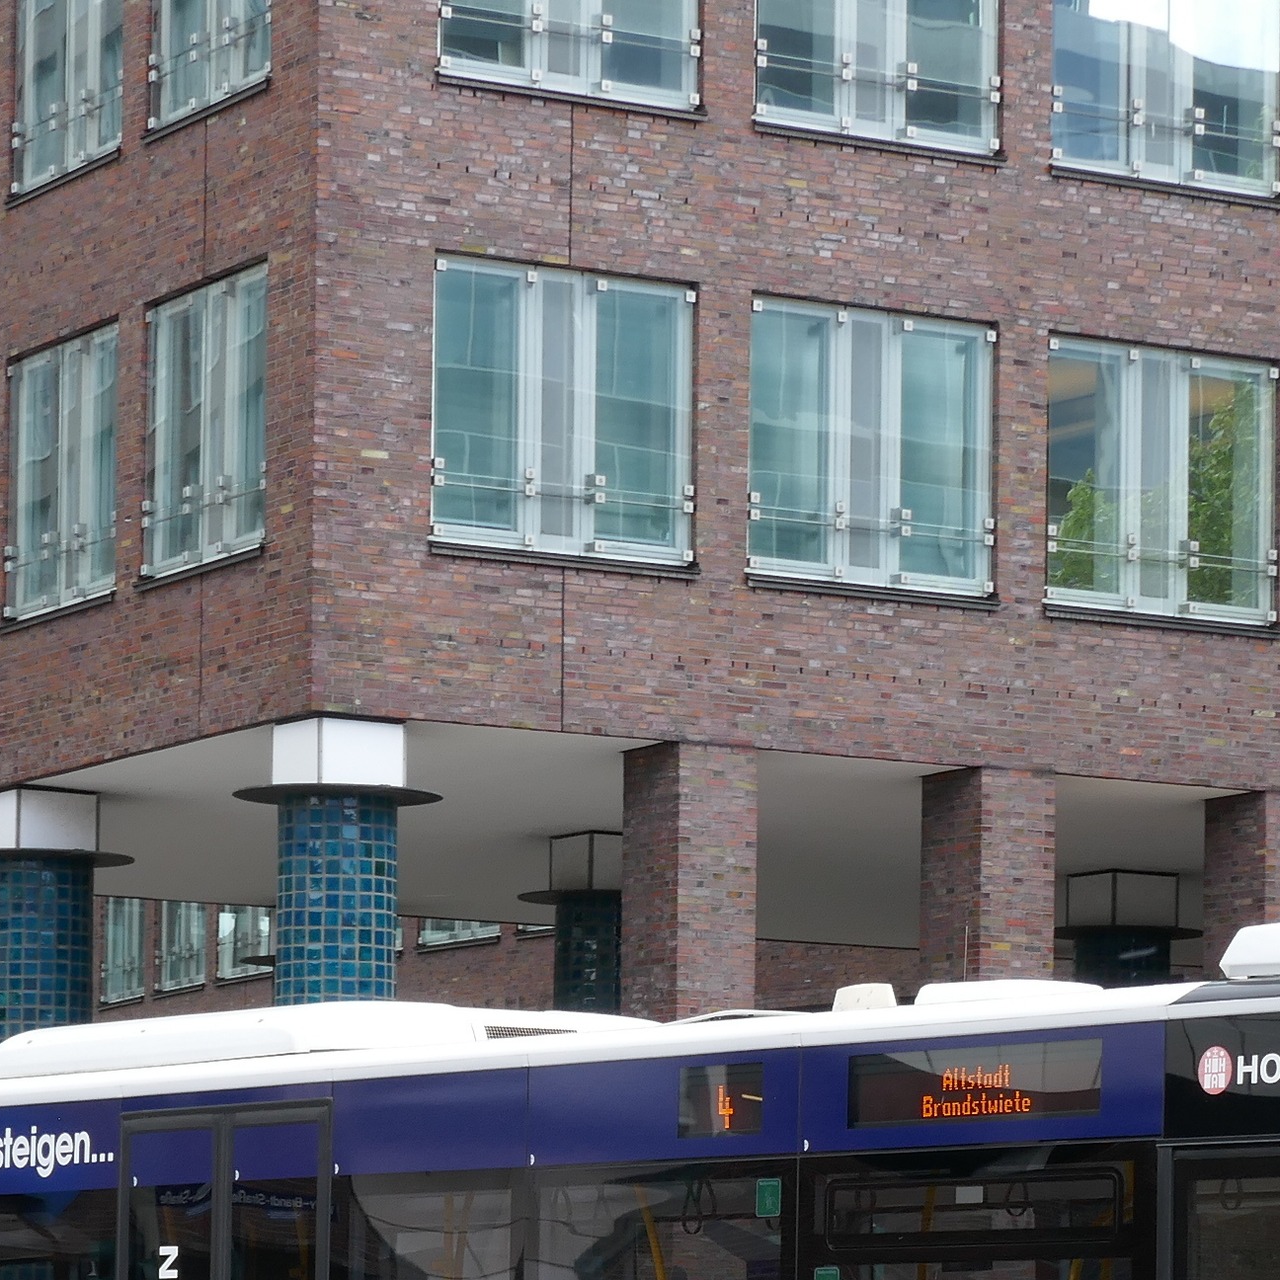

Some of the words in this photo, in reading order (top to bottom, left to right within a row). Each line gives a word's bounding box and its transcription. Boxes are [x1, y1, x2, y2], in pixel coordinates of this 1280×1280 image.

[942, 1064, 1010, 1091] Altstadt
[718, 1085, 734, 1129] 4
[922, 1090, 1031, 1118] Brandstwiete
